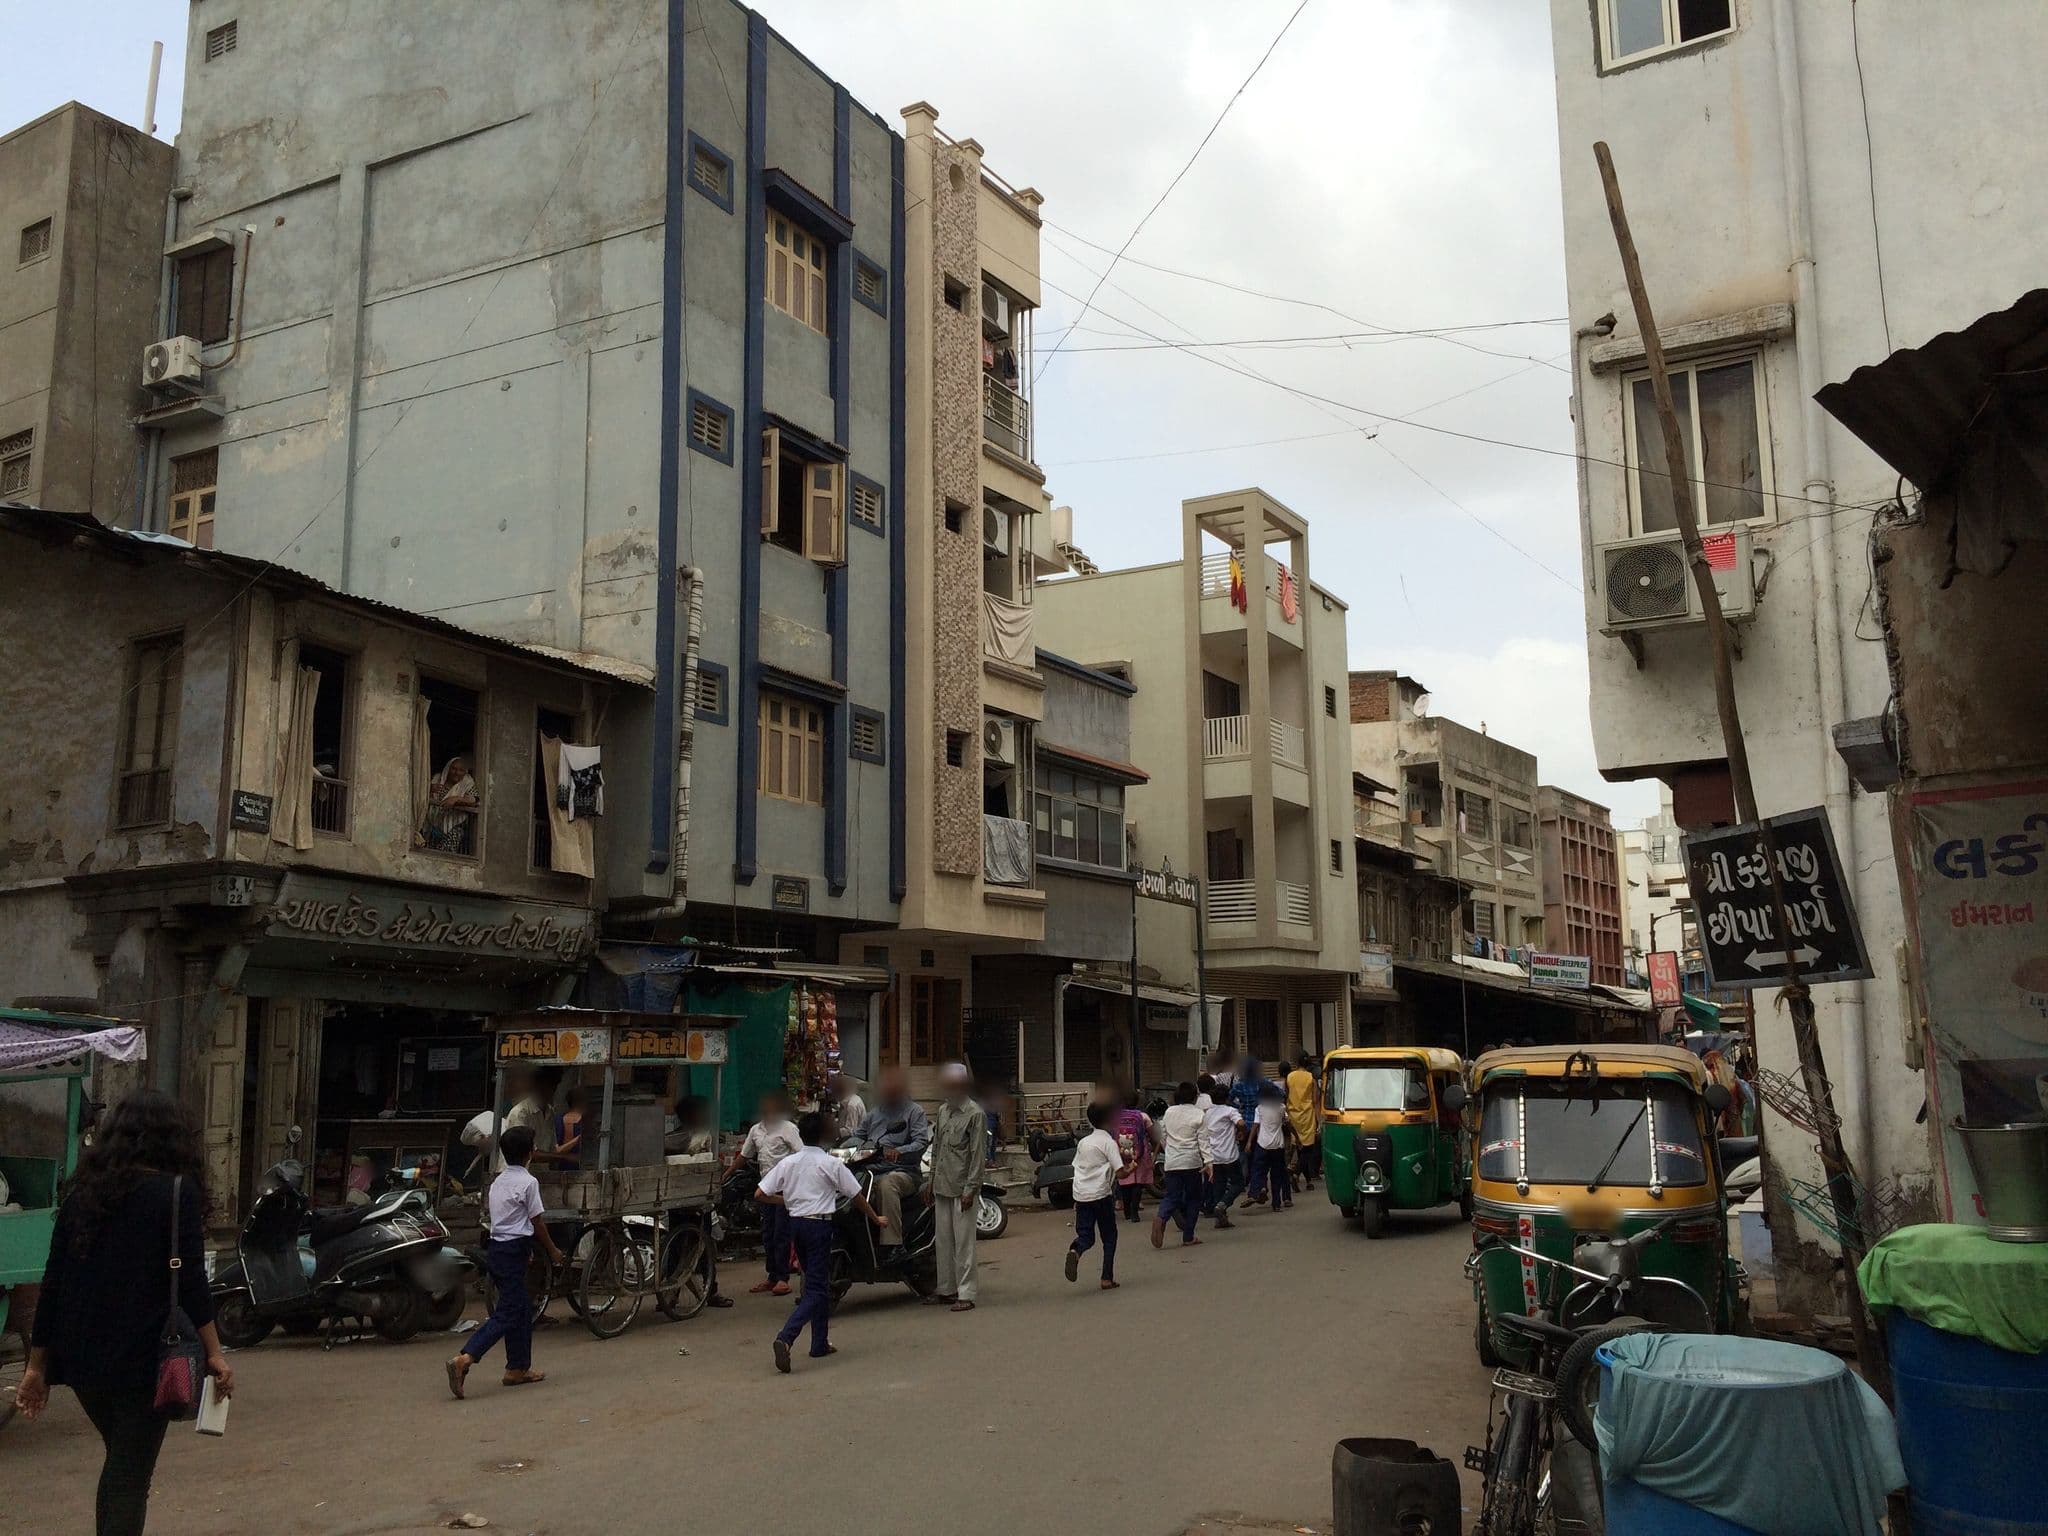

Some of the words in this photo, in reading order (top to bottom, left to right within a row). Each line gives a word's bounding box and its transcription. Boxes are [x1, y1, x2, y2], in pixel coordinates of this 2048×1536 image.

[1708, 902, 1774, 946] છીપા
[1950, 899, 2034, 928] ઈમરાન
[1533, 956, 1560, 967] UNIQUE
